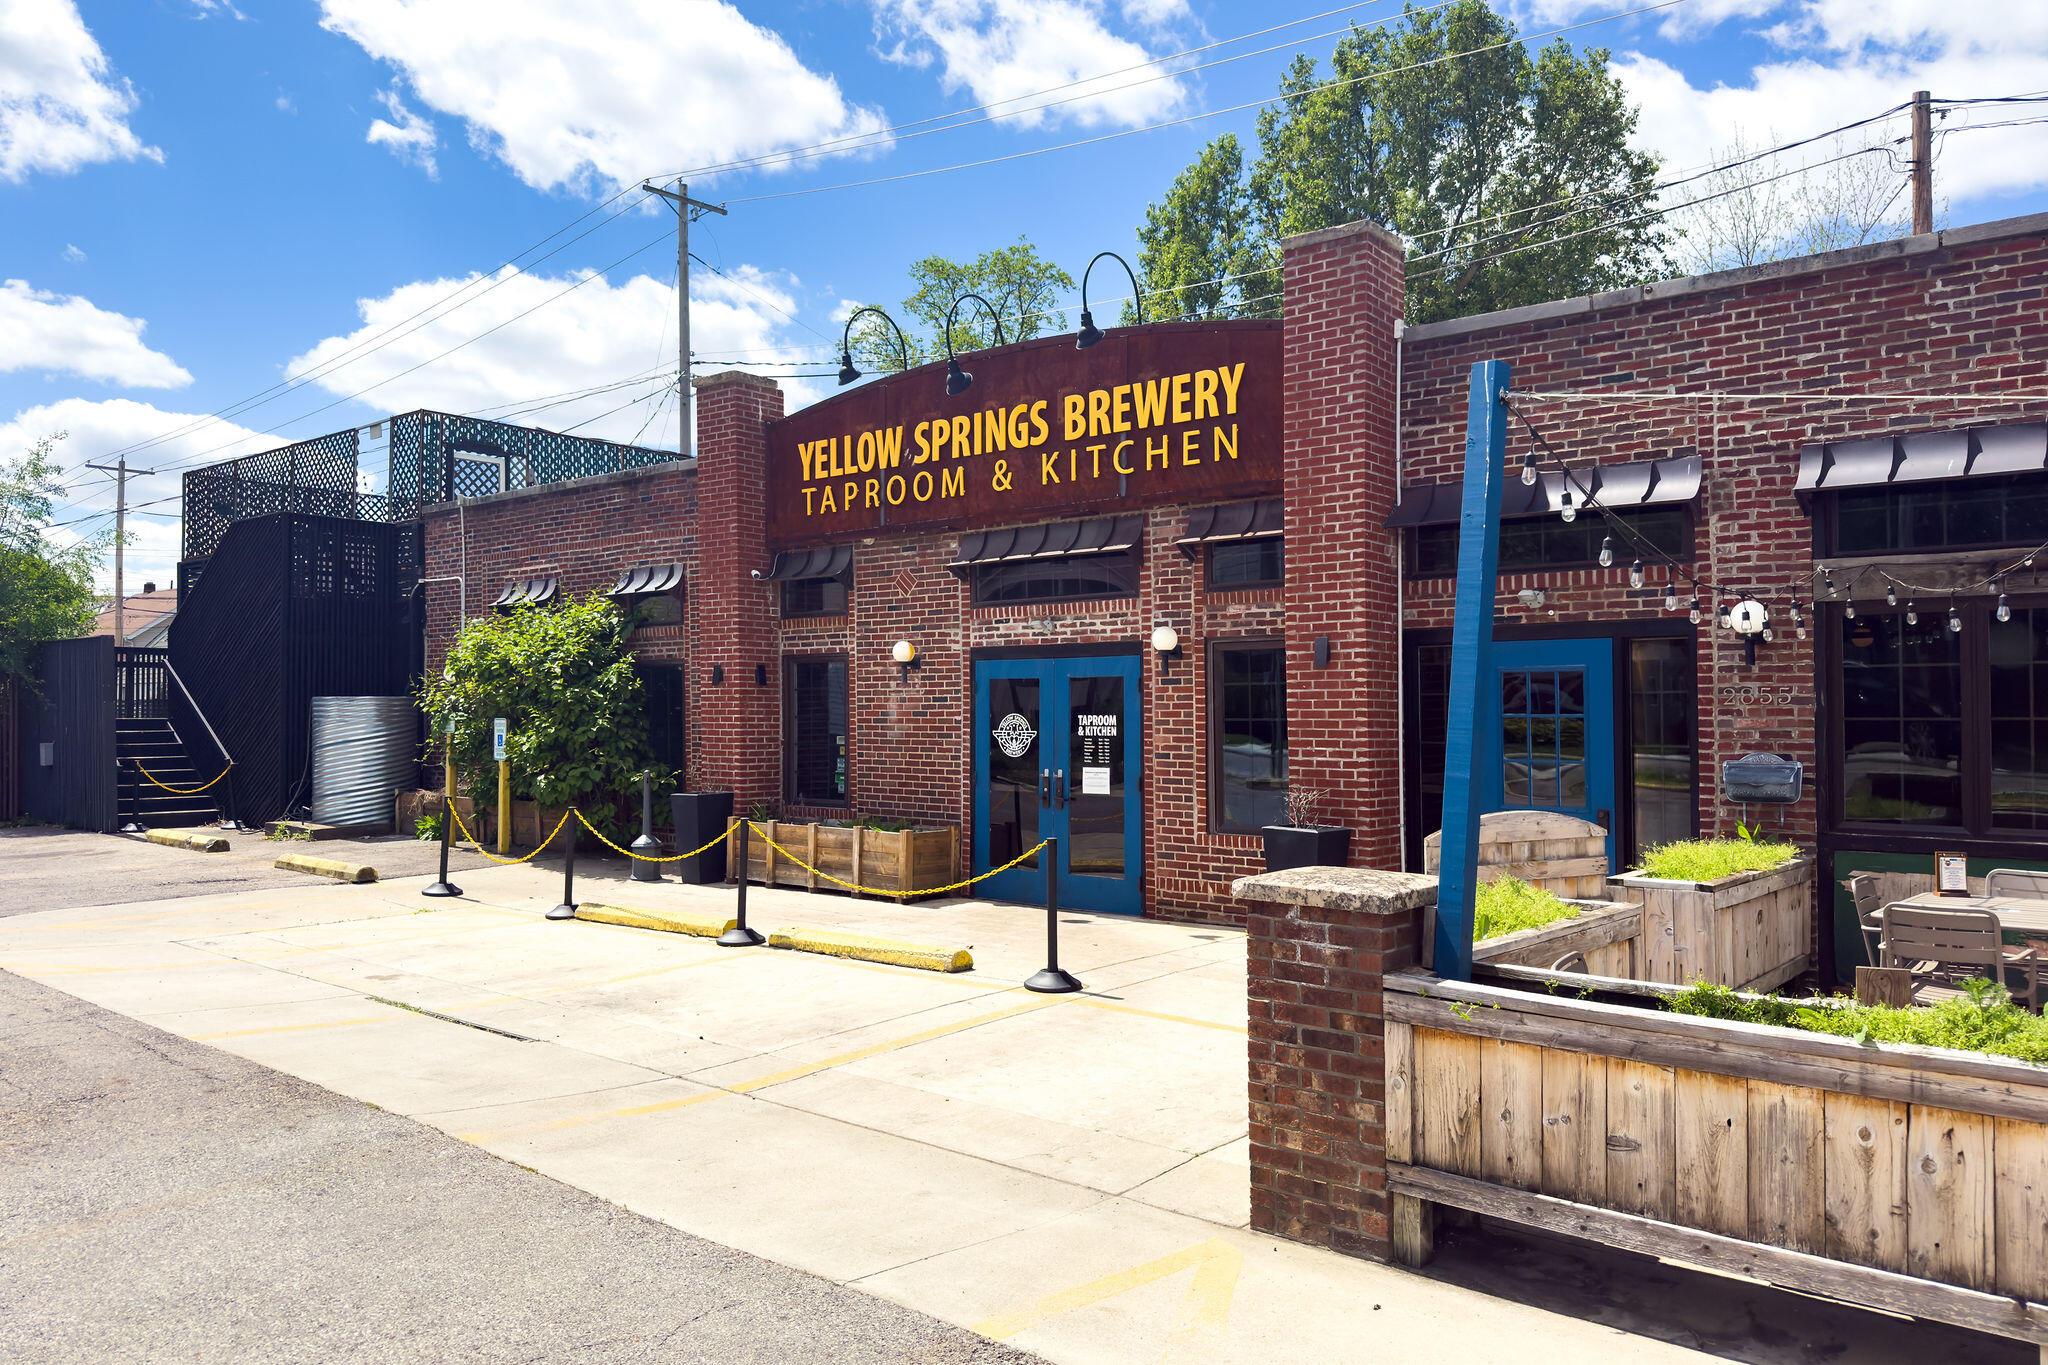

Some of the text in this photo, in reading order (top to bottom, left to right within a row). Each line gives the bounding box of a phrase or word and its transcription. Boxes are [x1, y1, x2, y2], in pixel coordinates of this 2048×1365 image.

[798, 363, 1245, 482] YELLOW SPRINGS BREWERY
[802, 424, 1239, 516] TAPROOM & KITCHEN
[1723, 686, 1792, 705] 2855
[1078, 715, 1117, 726] TAPROOM
[1078, 726, 1117, 737] & KITCHEN
